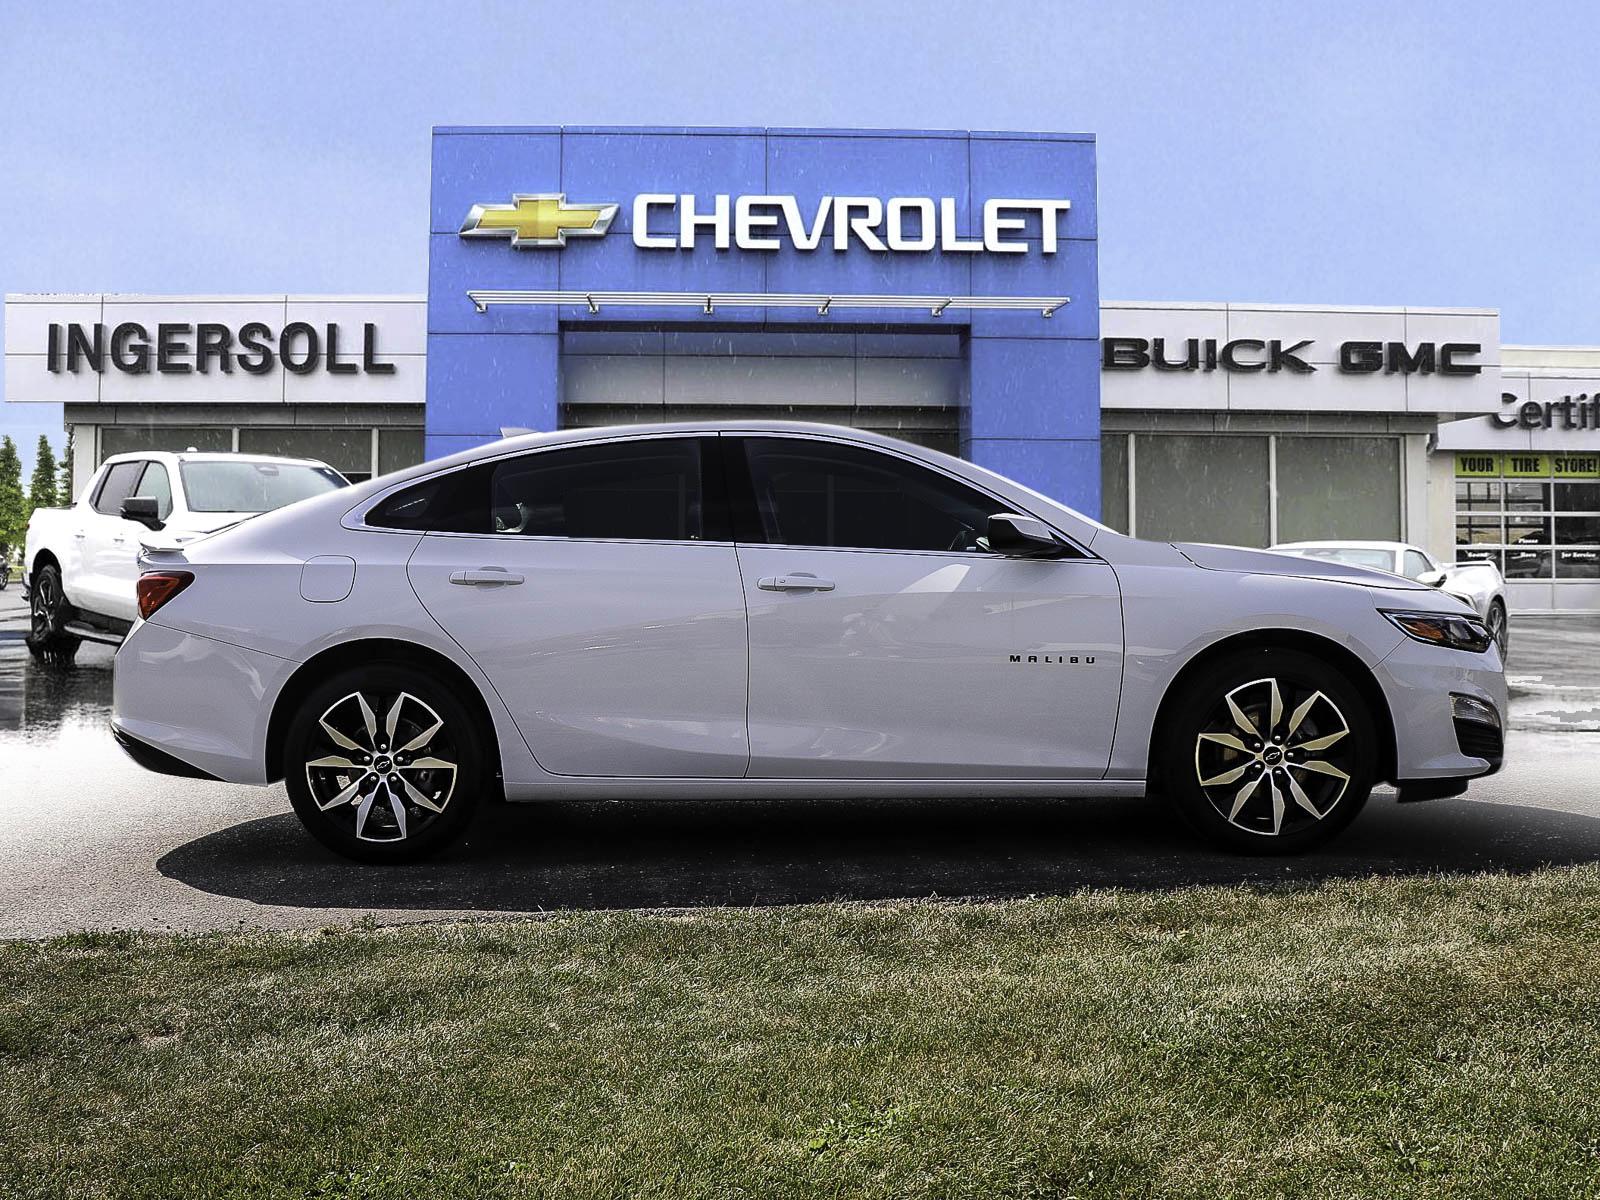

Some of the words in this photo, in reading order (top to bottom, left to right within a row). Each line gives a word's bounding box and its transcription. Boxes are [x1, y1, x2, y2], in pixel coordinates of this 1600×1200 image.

[632, 193, 1071, 254] CHEVROLET
[47, 322, 396, 374] INGERSOLL
[1103, 337, 1317, 373] BUICK
[1340, 340, 1481, 375] GMC
[1460, 457, 1494, 472] YOUR
[1511, 458, 1541, 473] TIRE
[1554, 457, 1597, 473] STORE!
[1009, 655, 1095, 664] MALIBU
